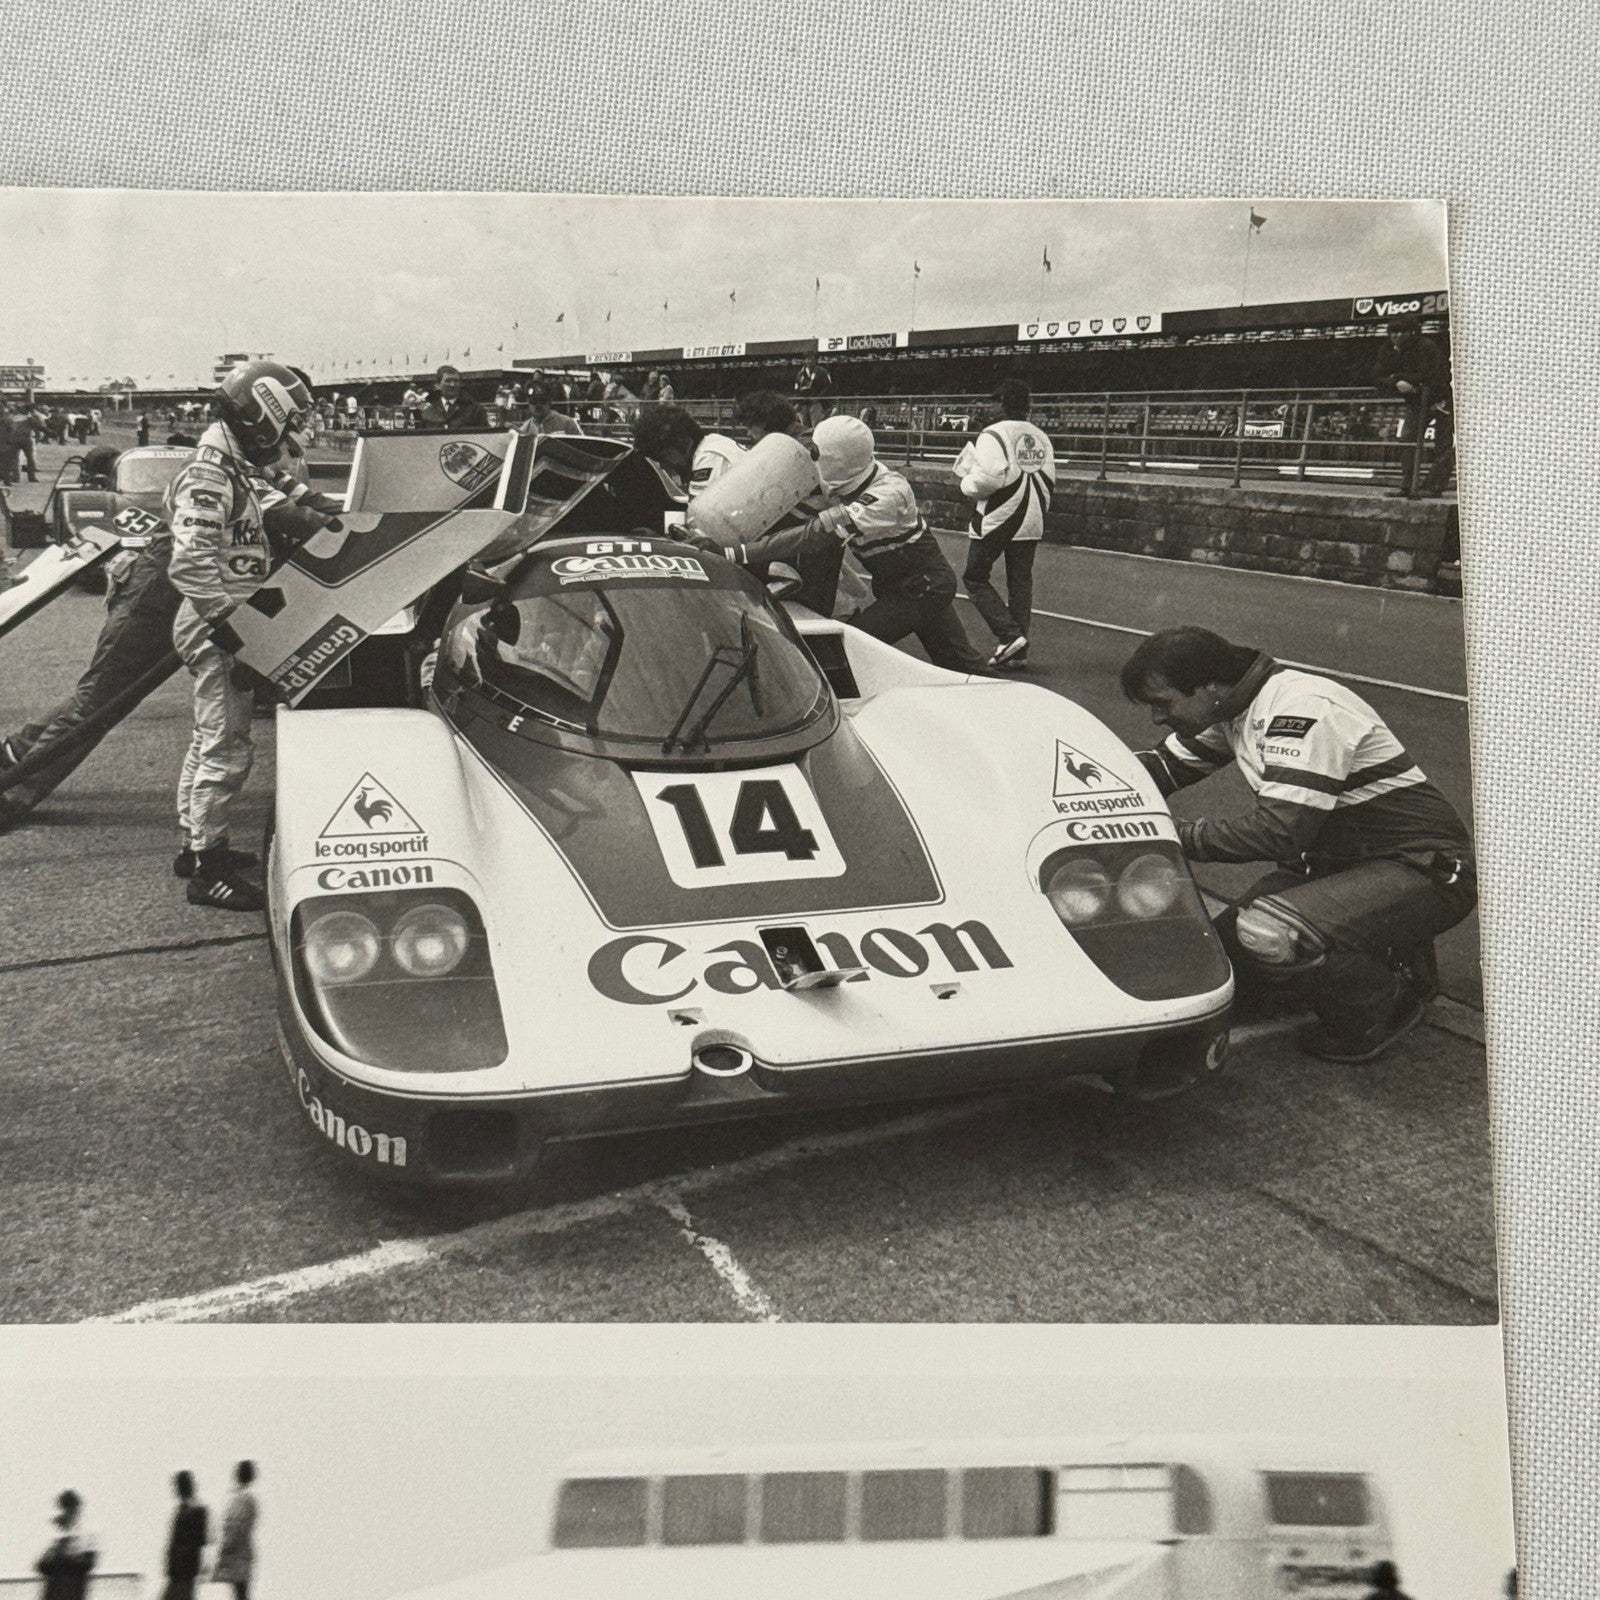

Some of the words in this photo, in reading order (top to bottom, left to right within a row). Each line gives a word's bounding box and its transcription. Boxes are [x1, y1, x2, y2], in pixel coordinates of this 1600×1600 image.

[1375, 301, 1420, 316] Visco
[849, 334, 892, 350] Lockheed
[1244, 429, 1279, 437] HAMPION
[1018, 449, 1045, 460] METRO
[114, 508, 160, 535] 35
[551, 555, 706, 577] Canon
[297, 625, 359, 677] Grand
[1052, 799, 1071, 814] le
[1070, 799, 1100, 814] coq
[1097, 792, 1145, 812] sportif
[655, 779, 821, 869] 14
[1066, 820, 1159, 841] Canon
[315, 840, 332, 858] le
[333, 841, 368, 858] coq
[369, 836, 429, 857] sportif
[317, 865, 434, 891] Canon
[298, 1067, 407, 1167] Canon
